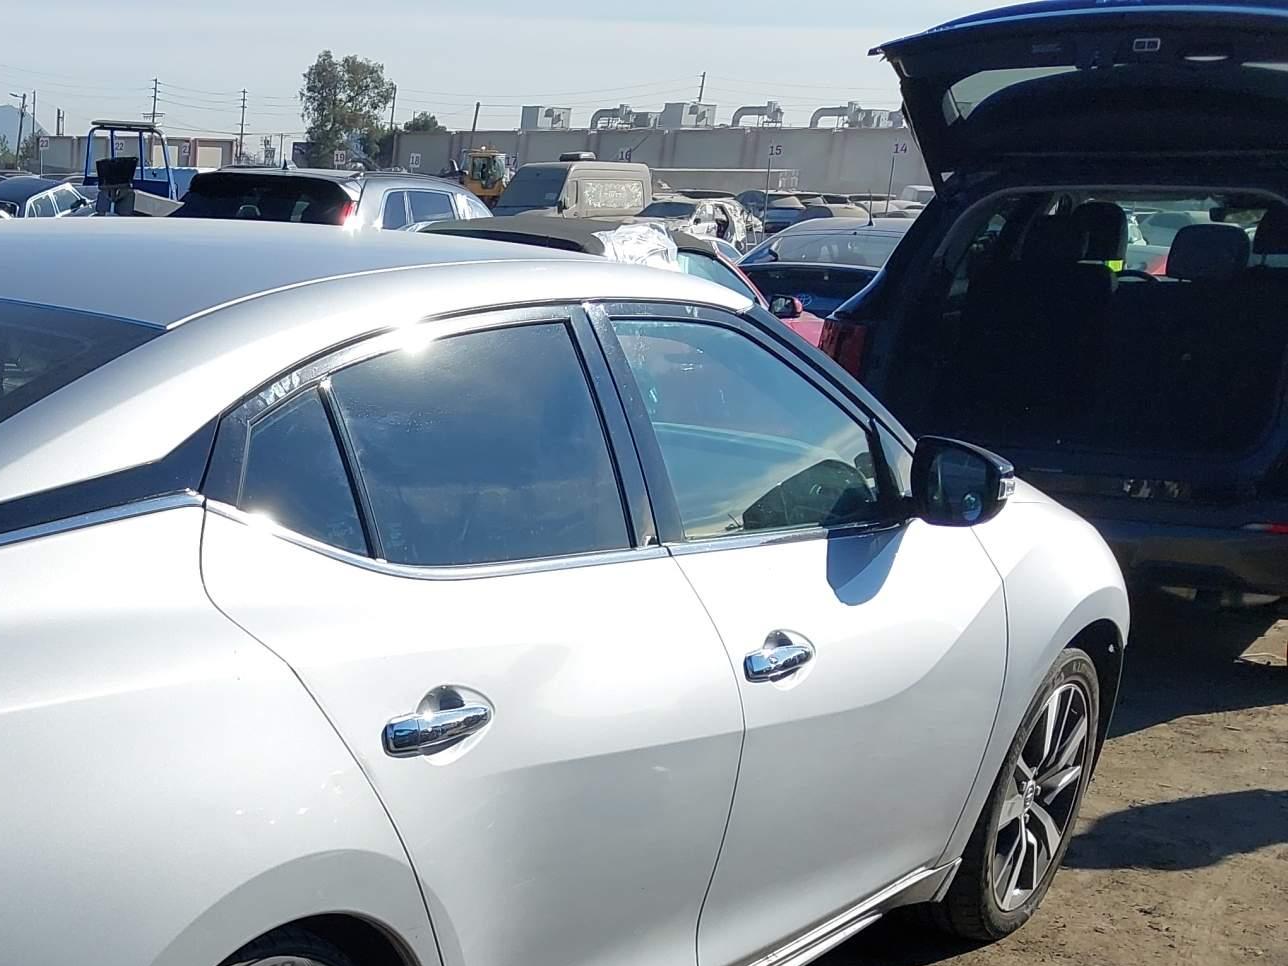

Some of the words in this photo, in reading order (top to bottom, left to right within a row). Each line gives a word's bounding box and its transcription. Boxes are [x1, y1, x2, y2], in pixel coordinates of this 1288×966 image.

[769, 145, 782, 156] 15
[893, 143, 907, 154] 14
[335, 153, 345, 162] 19
[411, 155, 420, 166] 18
[619, 150, 631, 160] 16
